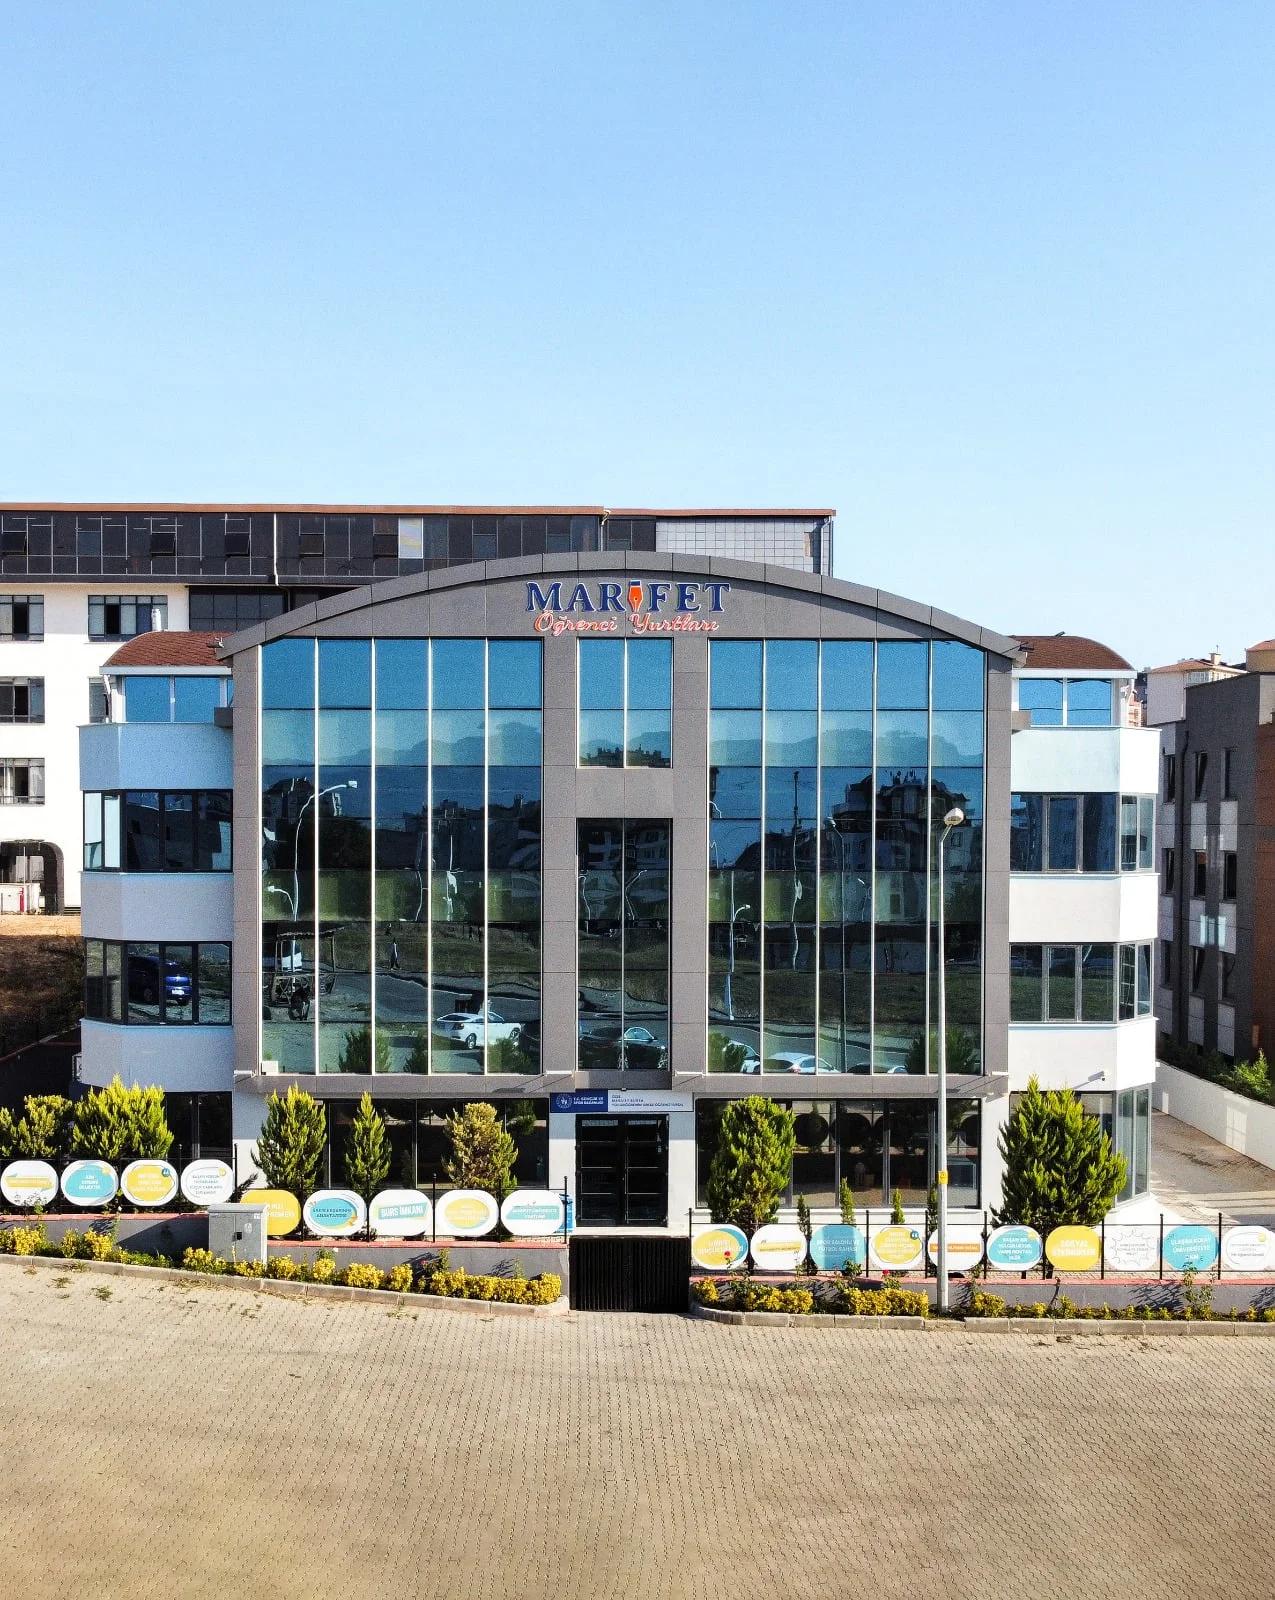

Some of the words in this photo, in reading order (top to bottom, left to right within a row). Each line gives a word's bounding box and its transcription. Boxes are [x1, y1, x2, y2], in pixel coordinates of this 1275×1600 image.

[534, 610, 618, 636] Öğrenci
[629, 613, 720, 635] Yurtları
[381, 1207, 399, 1217] BURS
